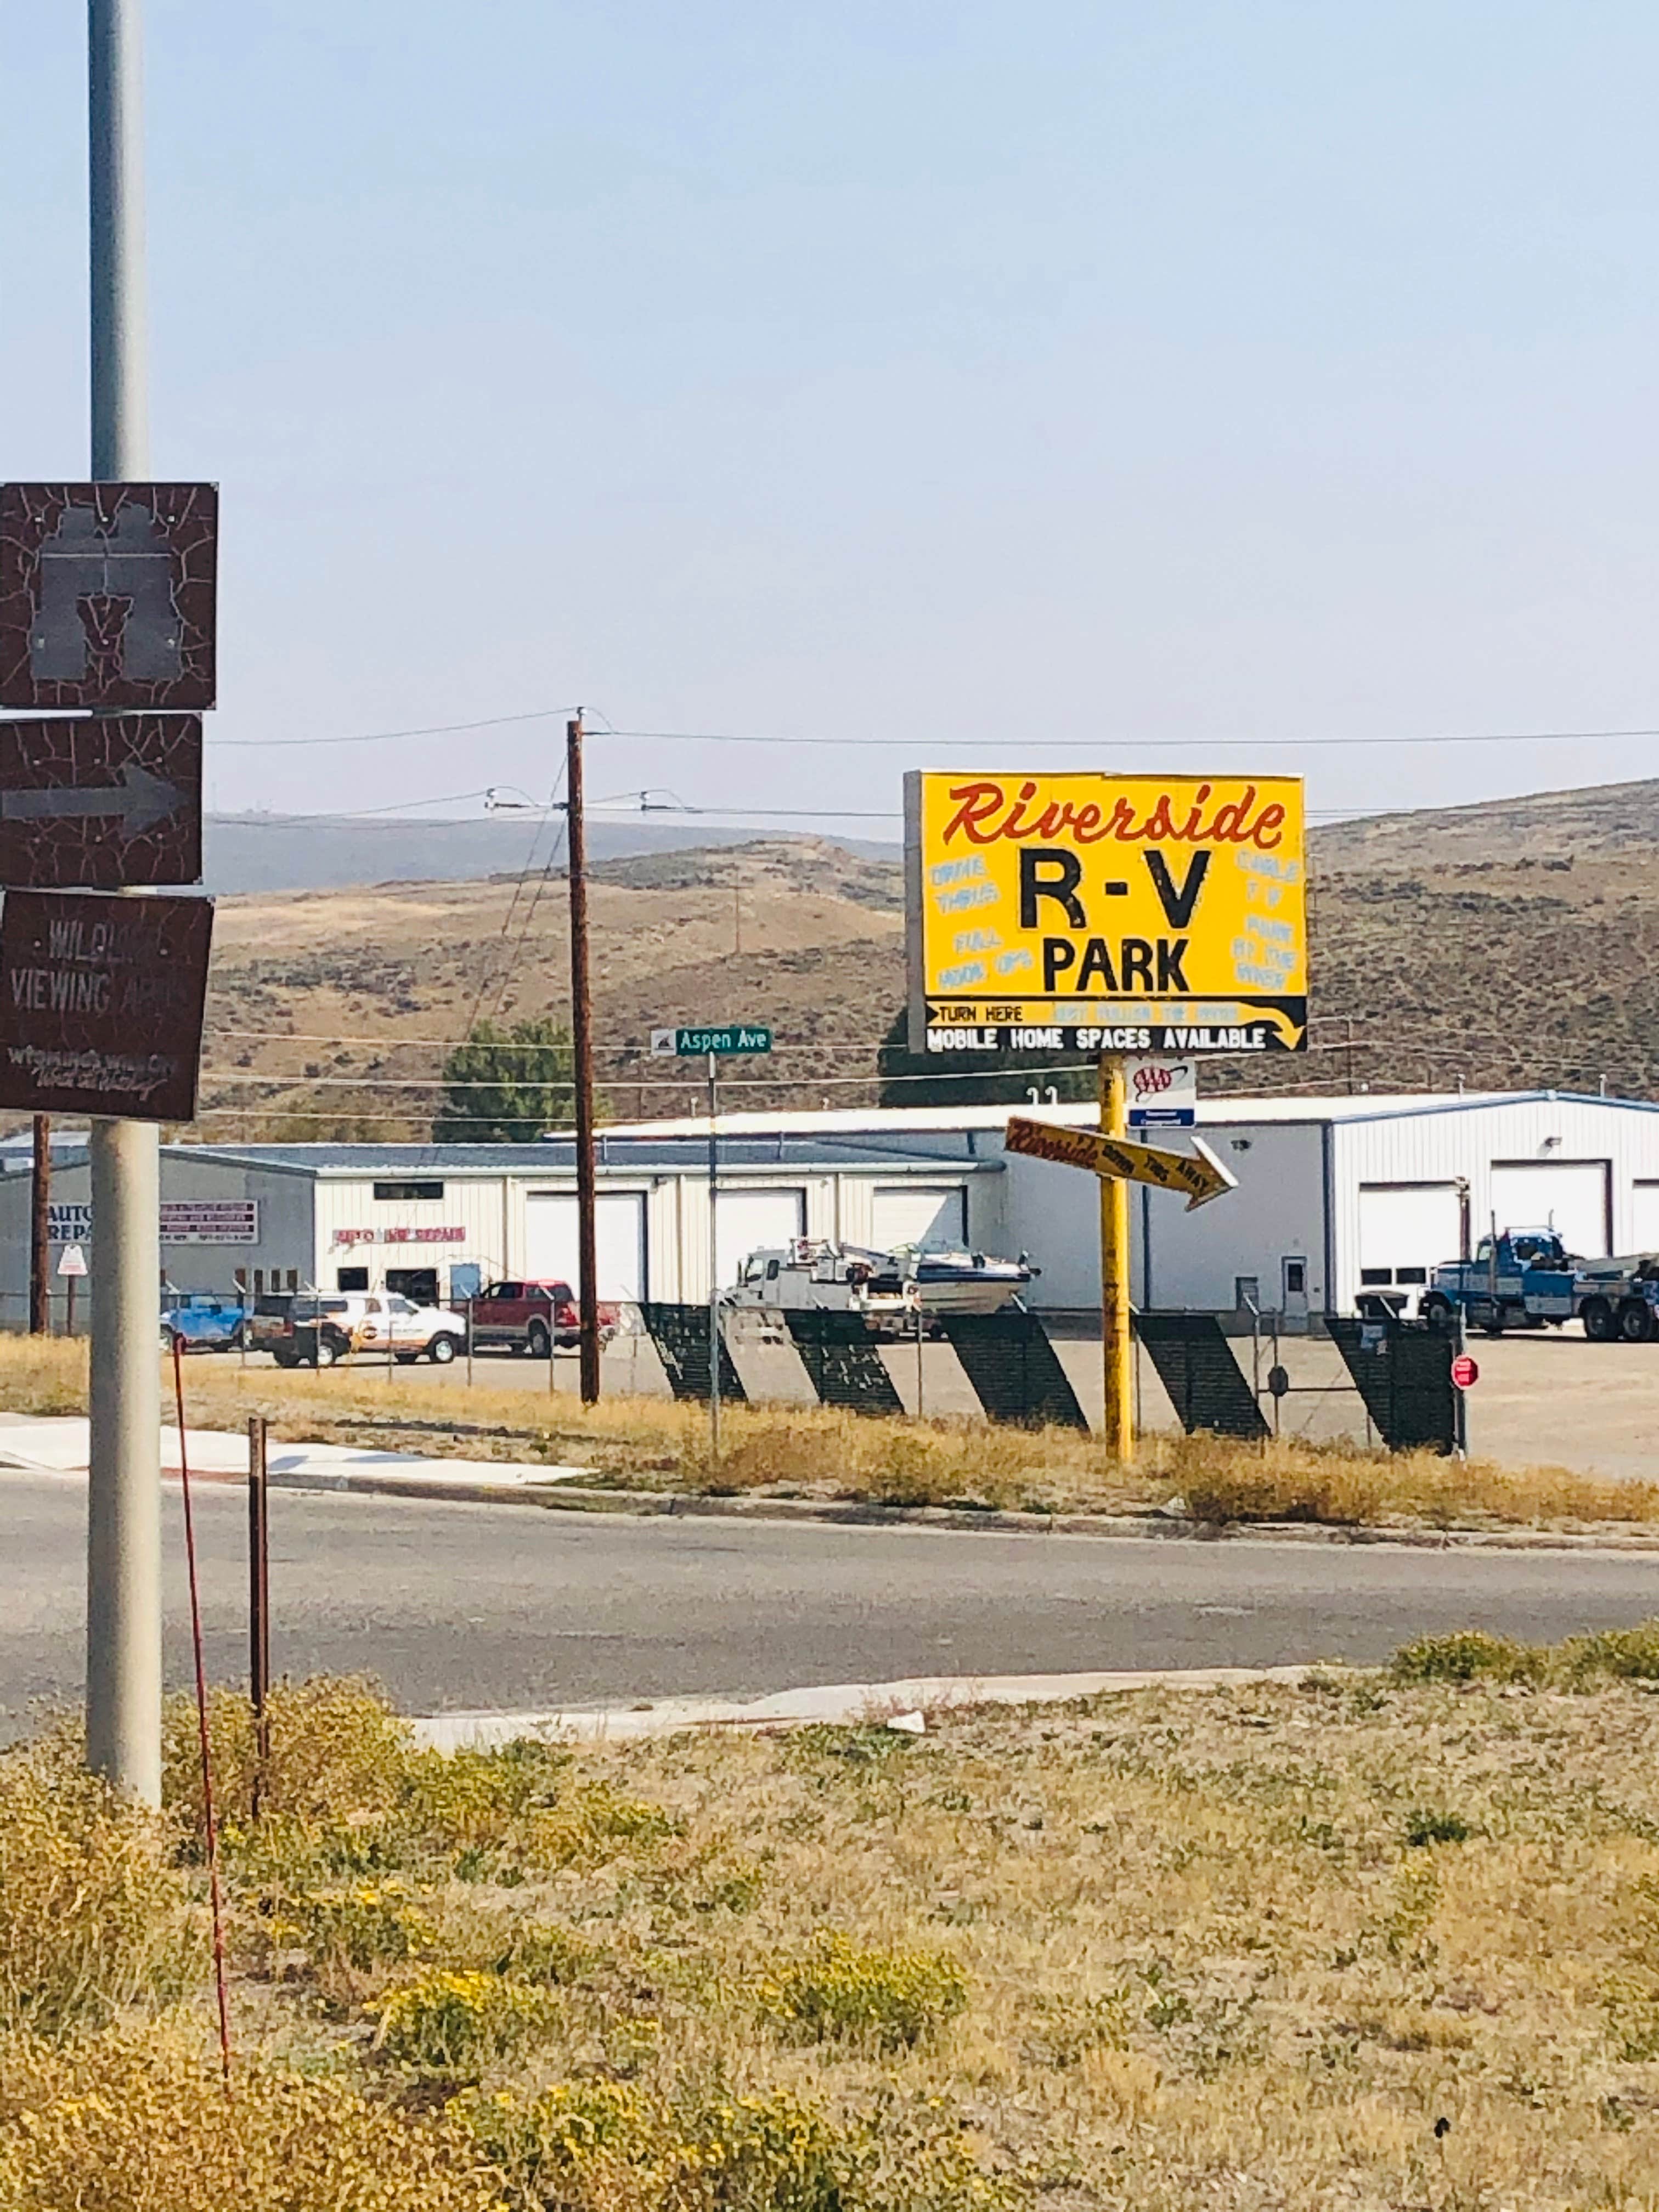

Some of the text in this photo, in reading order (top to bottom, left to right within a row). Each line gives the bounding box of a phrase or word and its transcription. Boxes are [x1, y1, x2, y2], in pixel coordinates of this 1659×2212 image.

[943, 782, 1285, 850] Riverside
[48, 919, 144, 964] WILDL
[1043, 938, 1189, 992] PARK
[10, 968, 110, 1014] VIEWING
[939, 1006, 977, 1022] TURN
[986, 1006, 1023, 1022] HERE
[680, 1030, 767, 1052] Aspen Ave
[927, 1028, 1266, 1050] MOBILE HOME SPACES AVAILABLE
